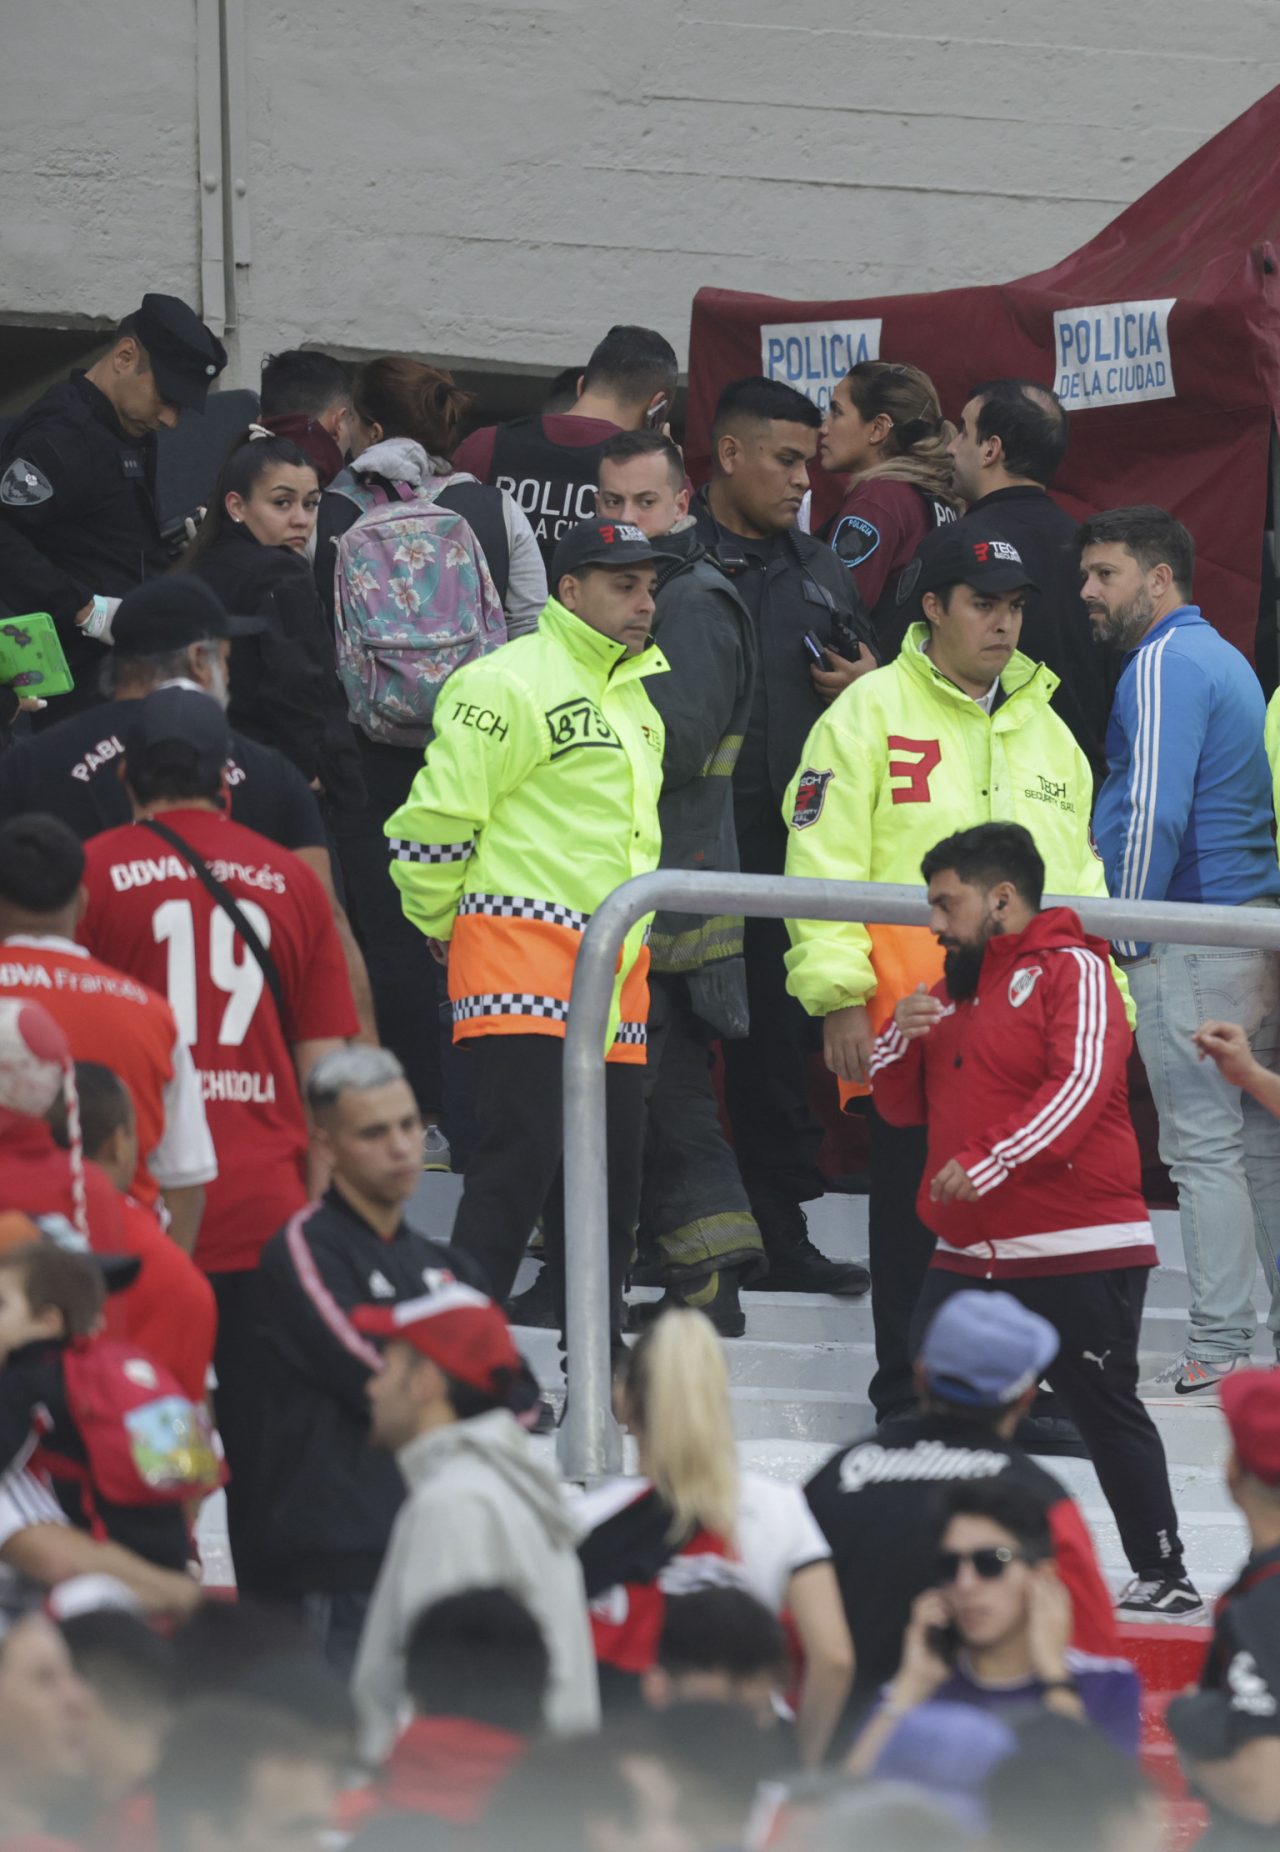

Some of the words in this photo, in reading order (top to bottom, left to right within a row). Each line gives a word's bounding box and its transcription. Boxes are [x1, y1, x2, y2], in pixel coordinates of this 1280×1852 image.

[1060, 311, 1162, 368] POLICIA
[1059, 372, 1081, 400] DE
[1082, 369, 1103, 397] LA
[1107, 361, 1166, 394] CIUDAD
[450, 702, 510, 743] TECH
[799, 775, 822, 786] ECH
[1036, 774, 1067, 799] TECH
[152, 898, 272, 1047] 19
